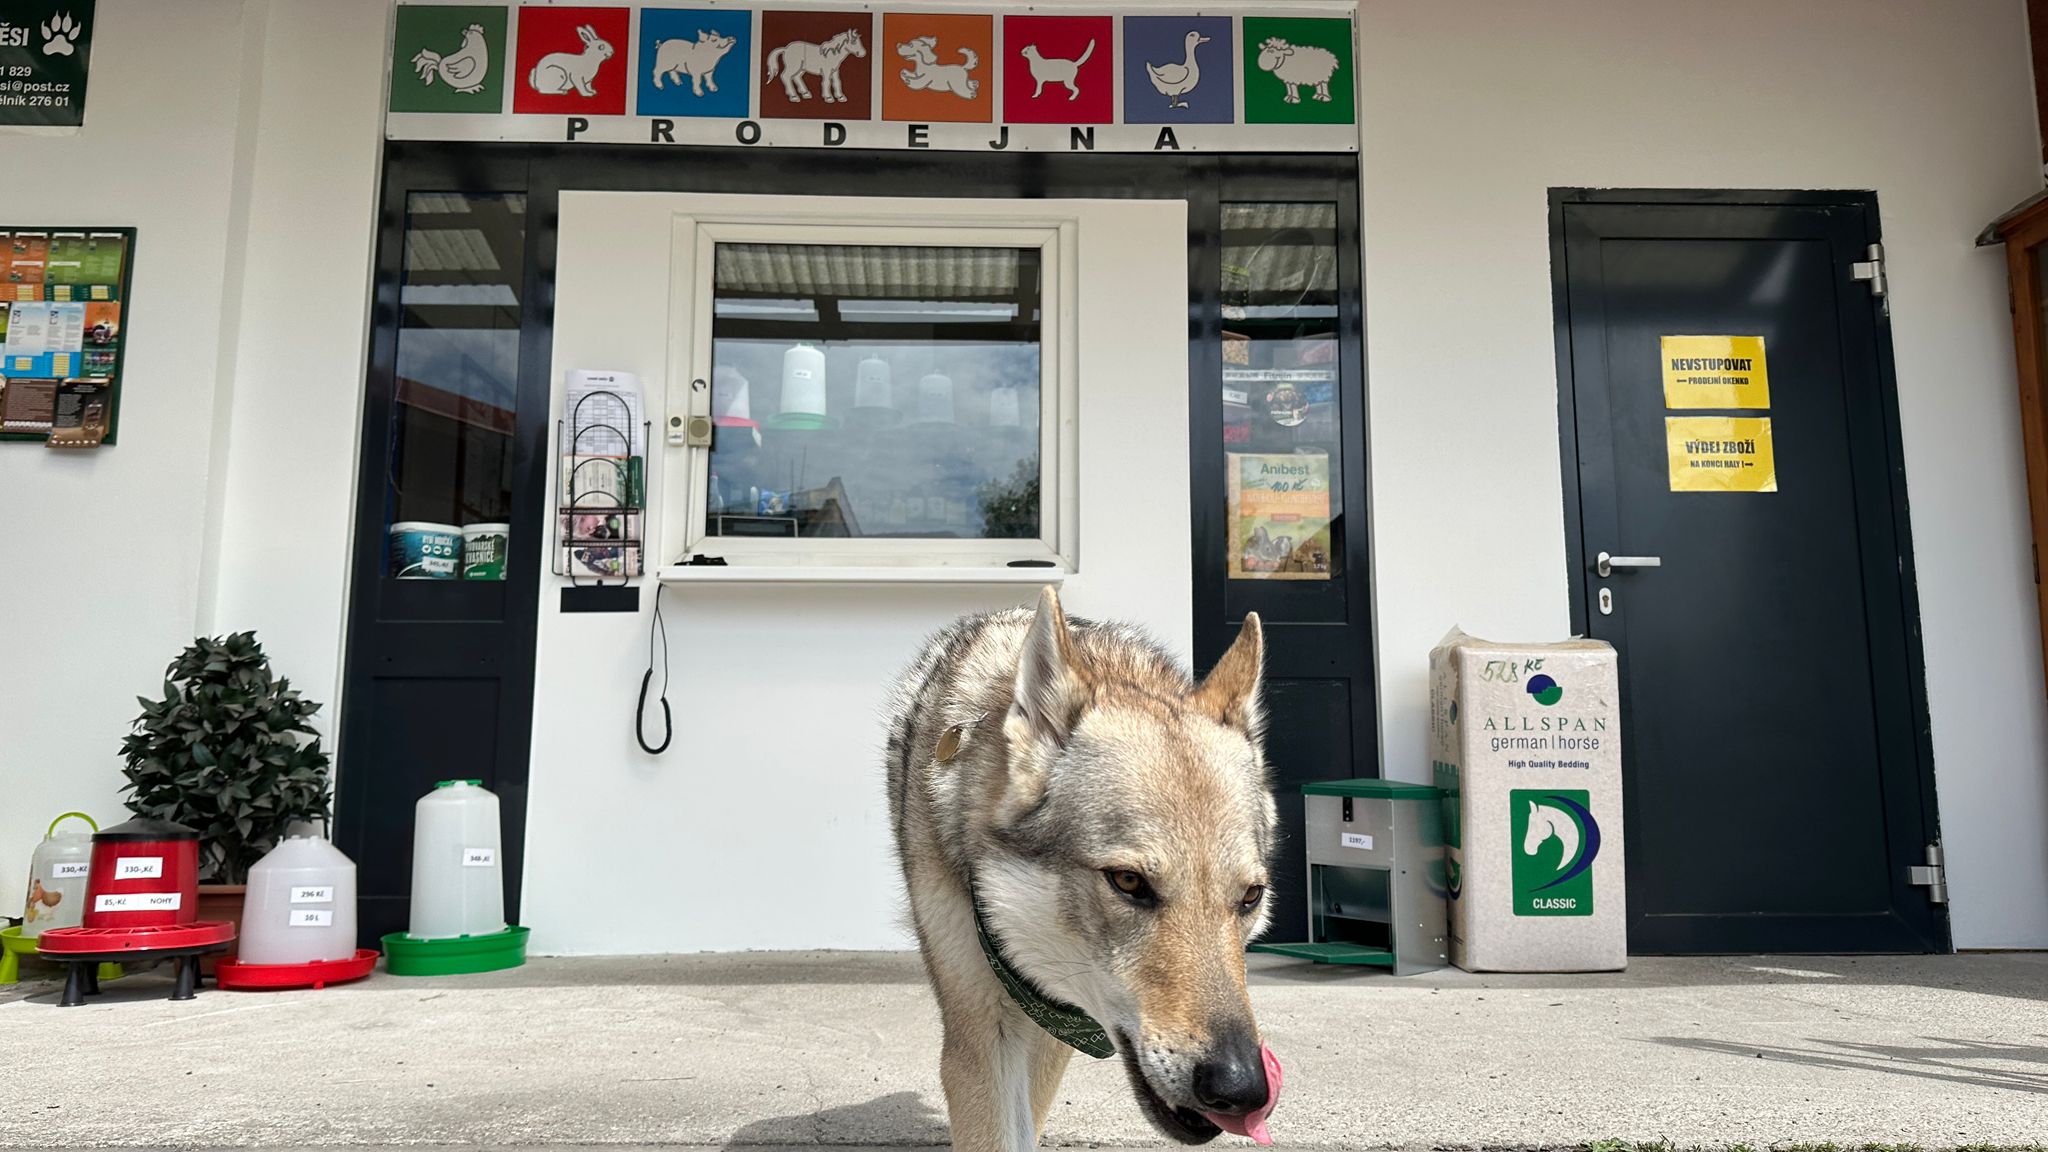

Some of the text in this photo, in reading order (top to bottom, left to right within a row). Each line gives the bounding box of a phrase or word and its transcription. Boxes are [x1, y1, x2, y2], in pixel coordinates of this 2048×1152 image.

[9, 66, 32, 77] 829
[0, 80, 70, 93] si@post.cz
[29, 96, 52, 107] 276
[55, 96, 69, 107] 01
[566, 117, 1180, 151] PRODEJNA
[1671, 358, 1752, 371] NEVSTUPOVAT
[1688, 376, 1749, 385] PRODEJNÍ OKENKO
[1685, 439, 1755, 454] VÝDEJ ZBOŽÍ
[1261, 463, 1310, 475] Anibest
[1690, 460, 1700, 468] NA
[1701, 460, 1723, 468] KONCI
[1724, 460, 1740, 469] HALY
[1484, 717, 1606, 731] ALLSPAN
[1491, 735, 1600, 752] german horse
[1508, 760, 1590, 769] High Quality Bedding
[1533, 897, 1576, 909] CLASSIC
